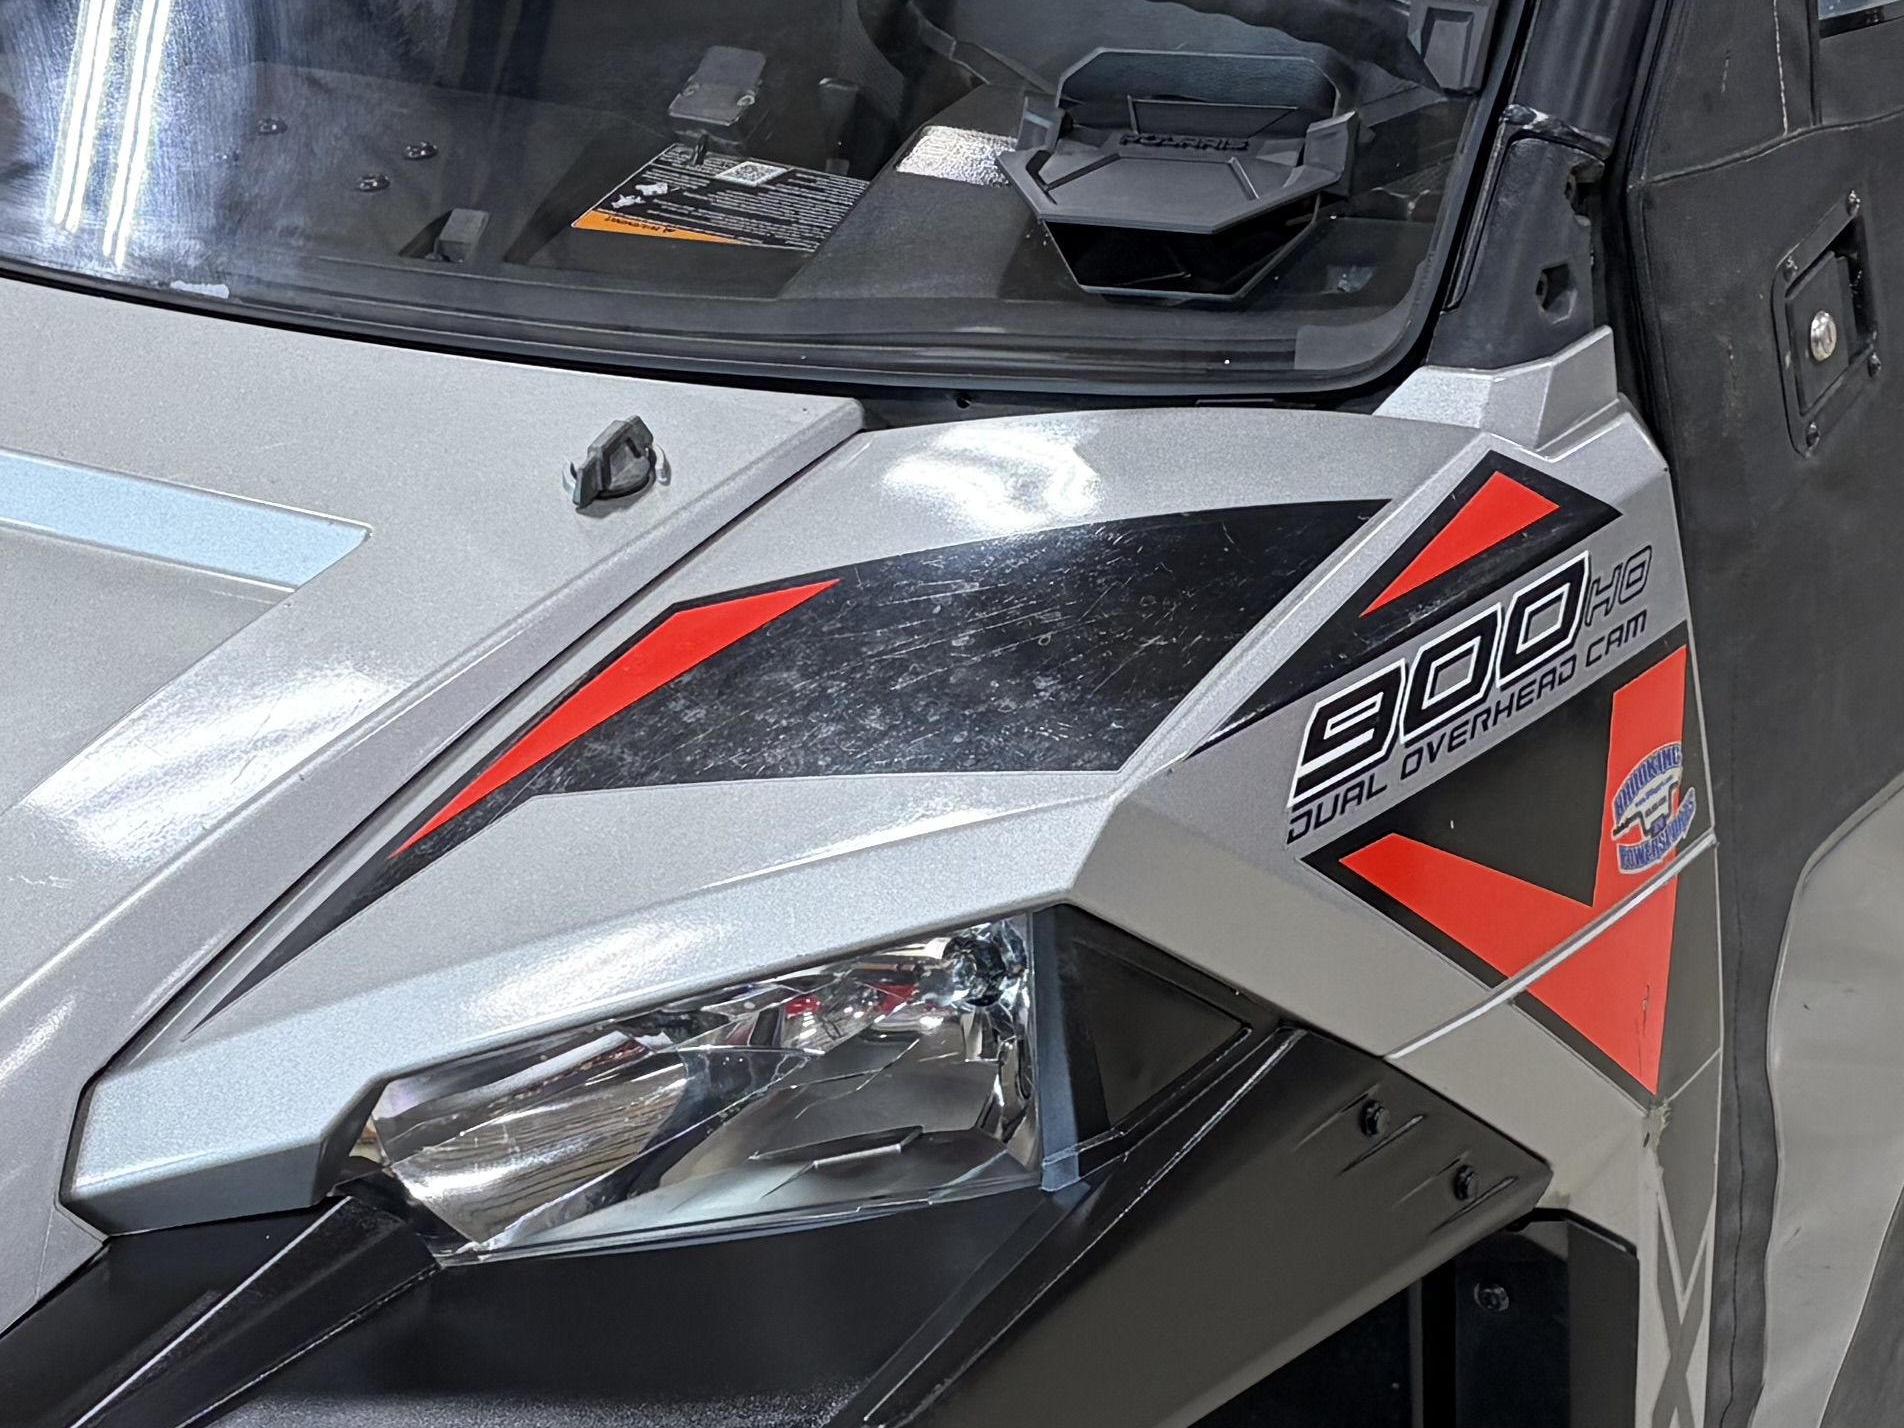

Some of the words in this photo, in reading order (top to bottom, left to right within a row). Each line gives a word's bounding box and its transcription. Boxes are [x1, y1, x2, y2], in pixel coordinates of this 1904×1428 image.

[1286, 550, 1590, 809] 900
[1286, 773, 1388, 845] DUAL
[1400, 654, 1578, 780] OVERHEAD
[1585, 608, 1648, 668] CAM
